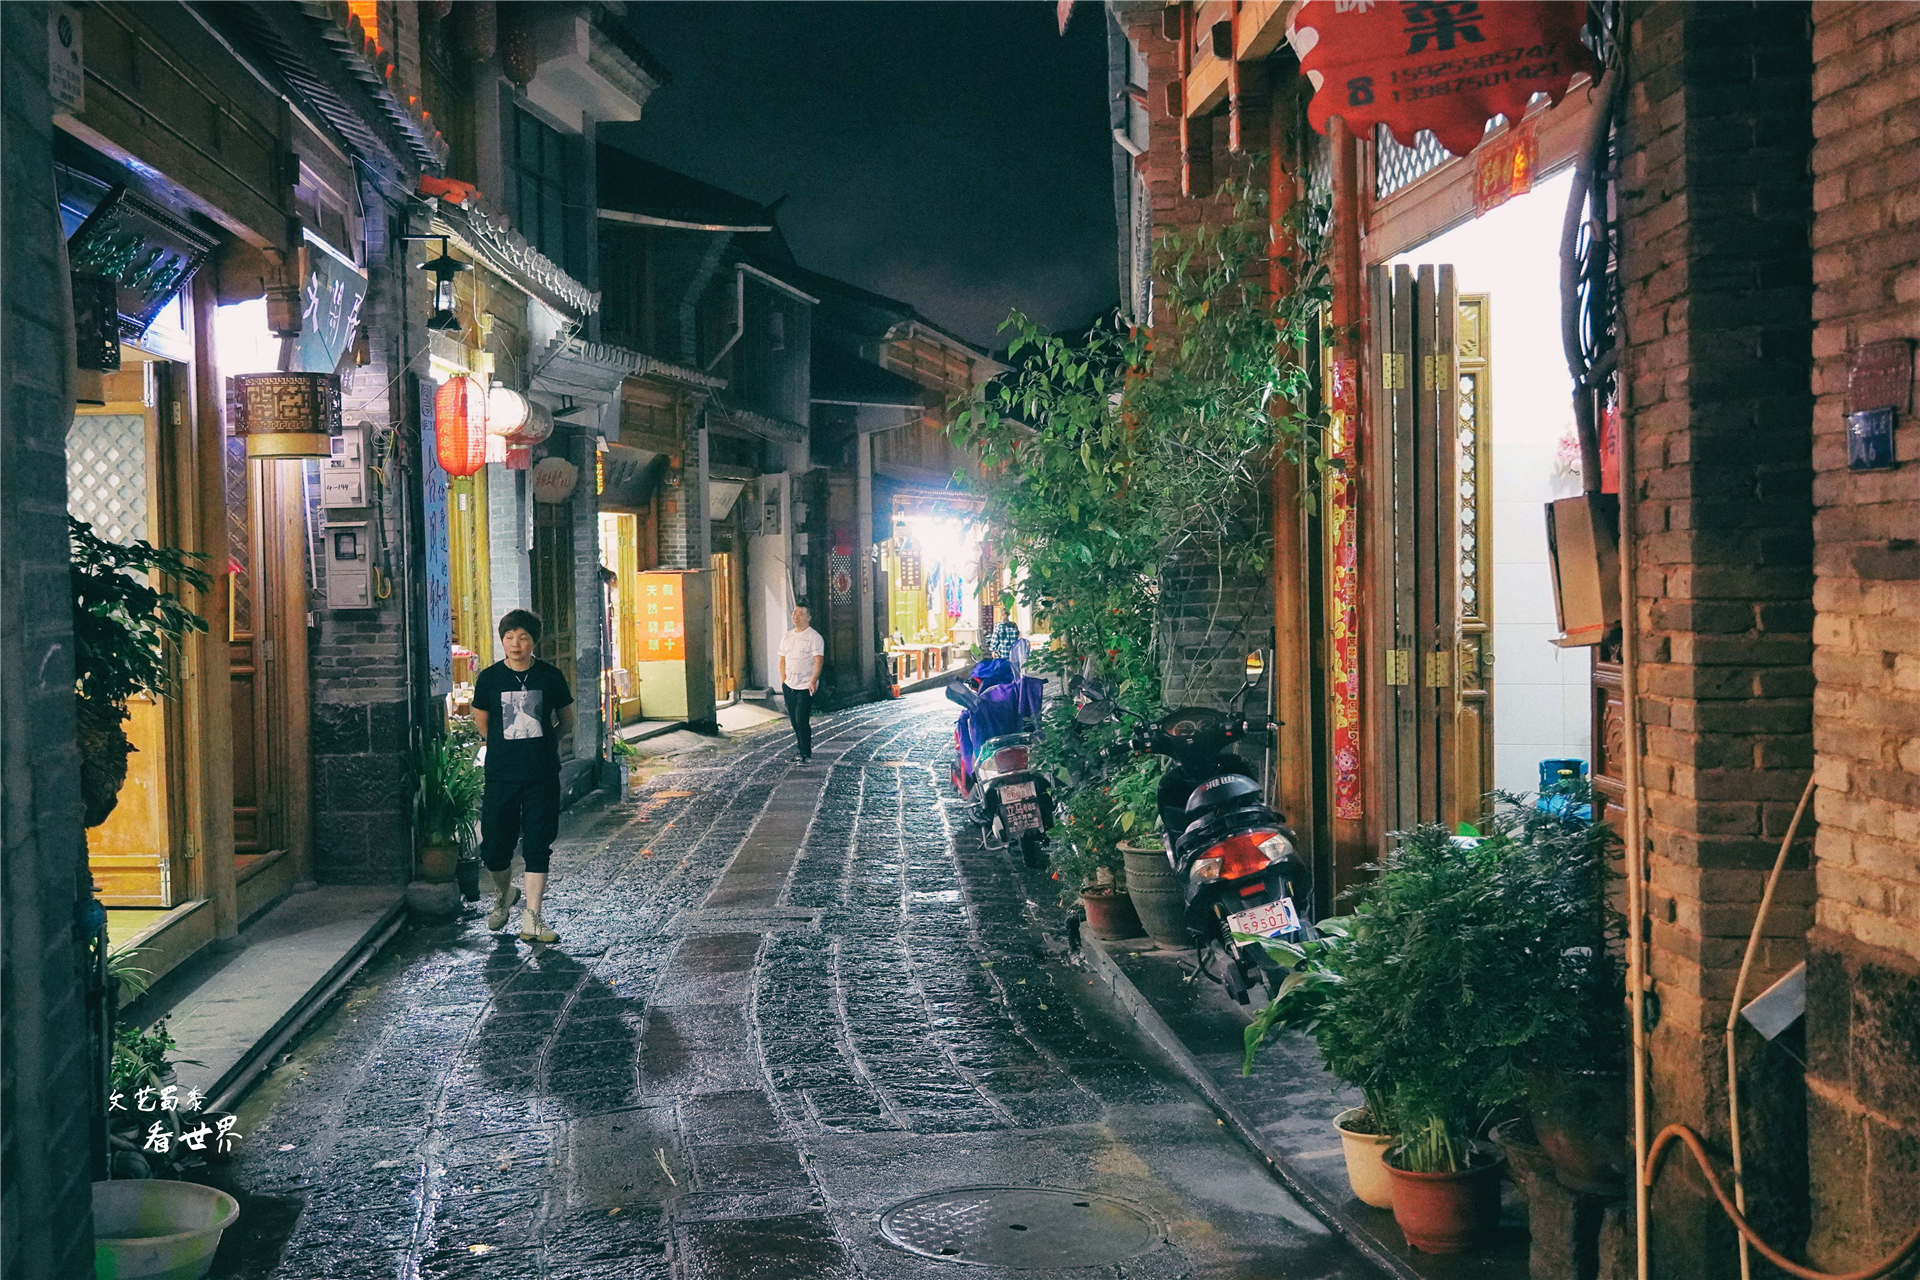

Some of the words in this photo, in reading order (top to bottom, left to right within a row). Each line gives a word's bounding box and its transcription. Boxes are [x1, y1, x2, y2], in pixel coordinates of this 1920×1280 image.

[646, 584, 659, 651] 天然翡翠
[662, 584, 676, 651] 假一赔十
[1243, 913, 1284, 934] 59507
